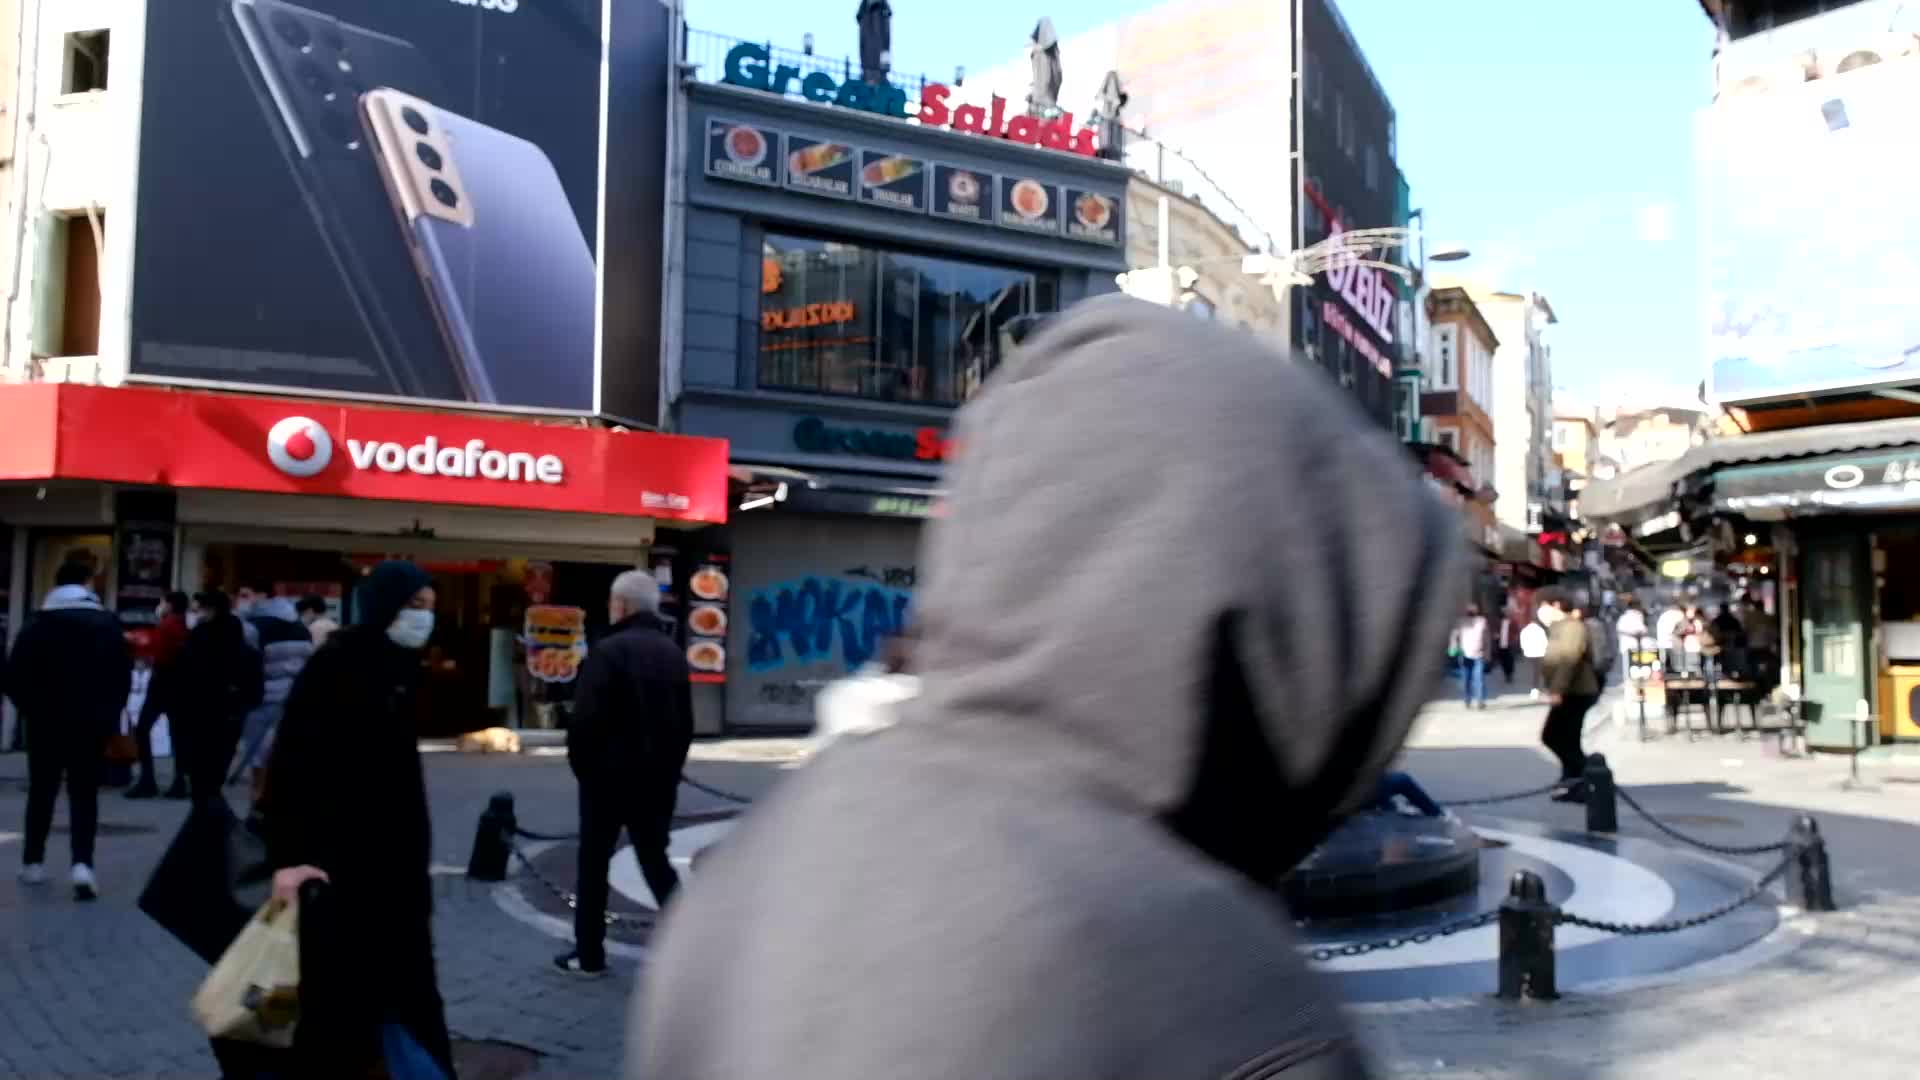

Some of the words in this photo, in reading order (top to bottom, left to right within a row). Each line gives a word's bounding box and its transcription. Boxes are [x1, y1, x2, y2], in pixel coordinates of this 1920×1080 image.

[723, 42, 908, 118] Green
[920, 82, 1097, 156] Salads
[346, 435, 564, 484] vodafone
